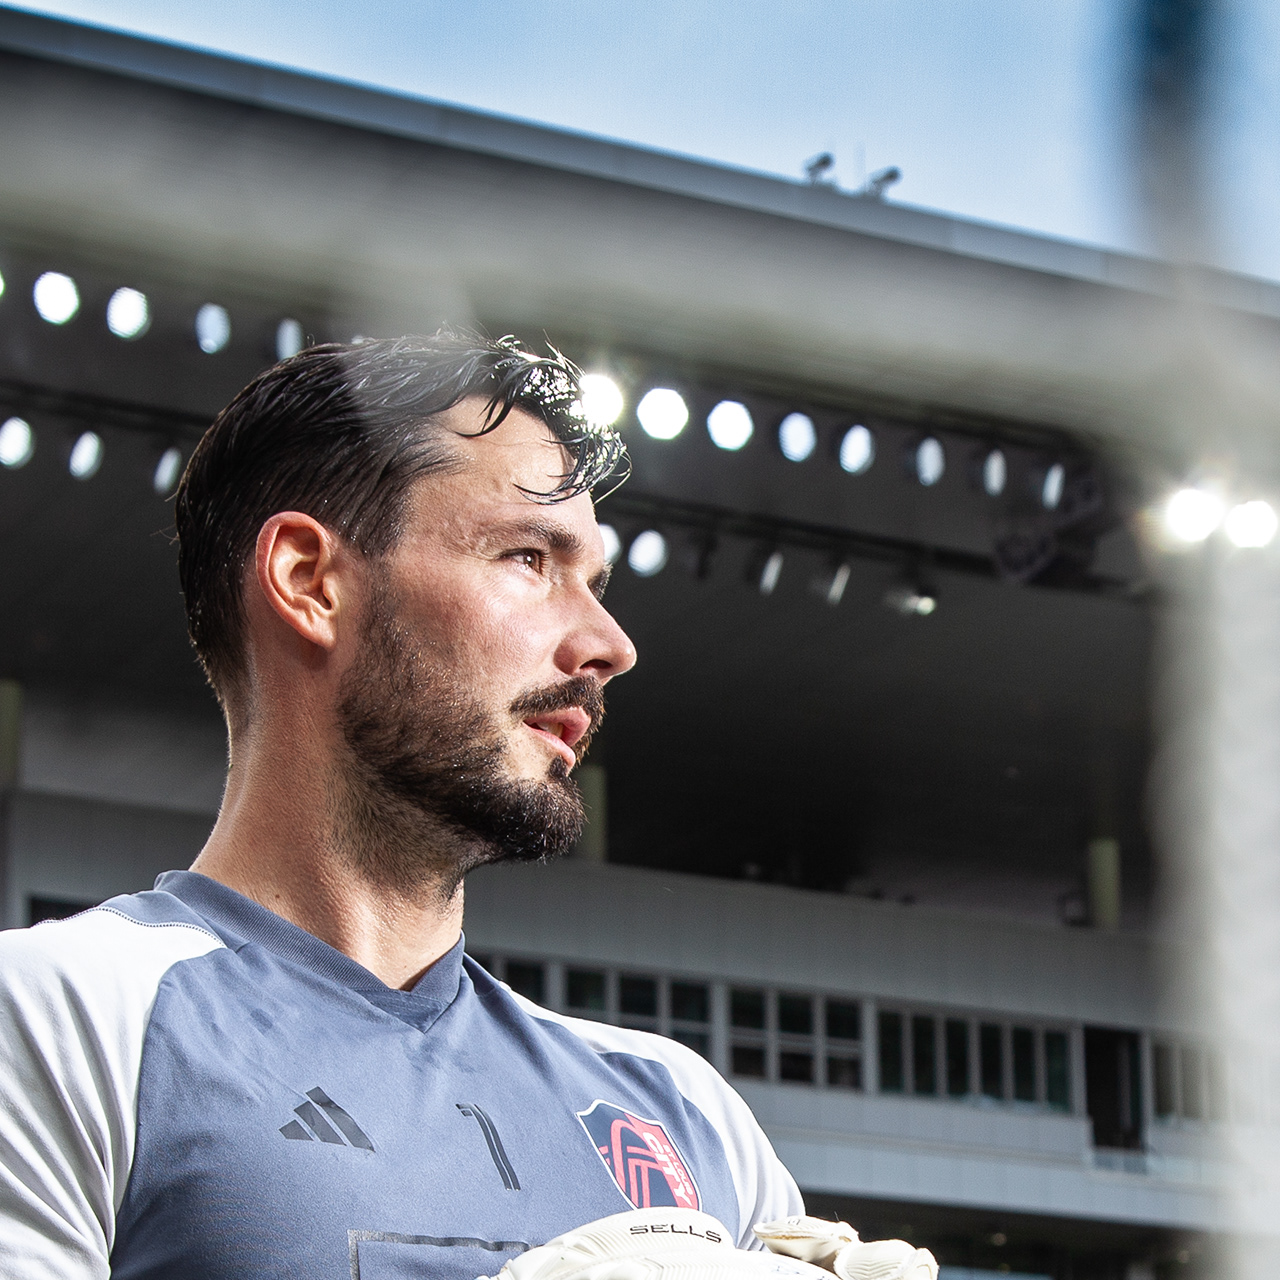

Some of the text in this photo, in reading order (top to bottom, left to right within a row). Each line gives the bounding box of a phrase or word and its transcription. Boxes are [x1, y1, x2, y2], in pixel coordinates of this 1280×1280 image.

[455, 1102, 521, 1191] 1
[642, 1131, 693, 1207] CITY
[629, 1223, 722, 1244] SELLS
